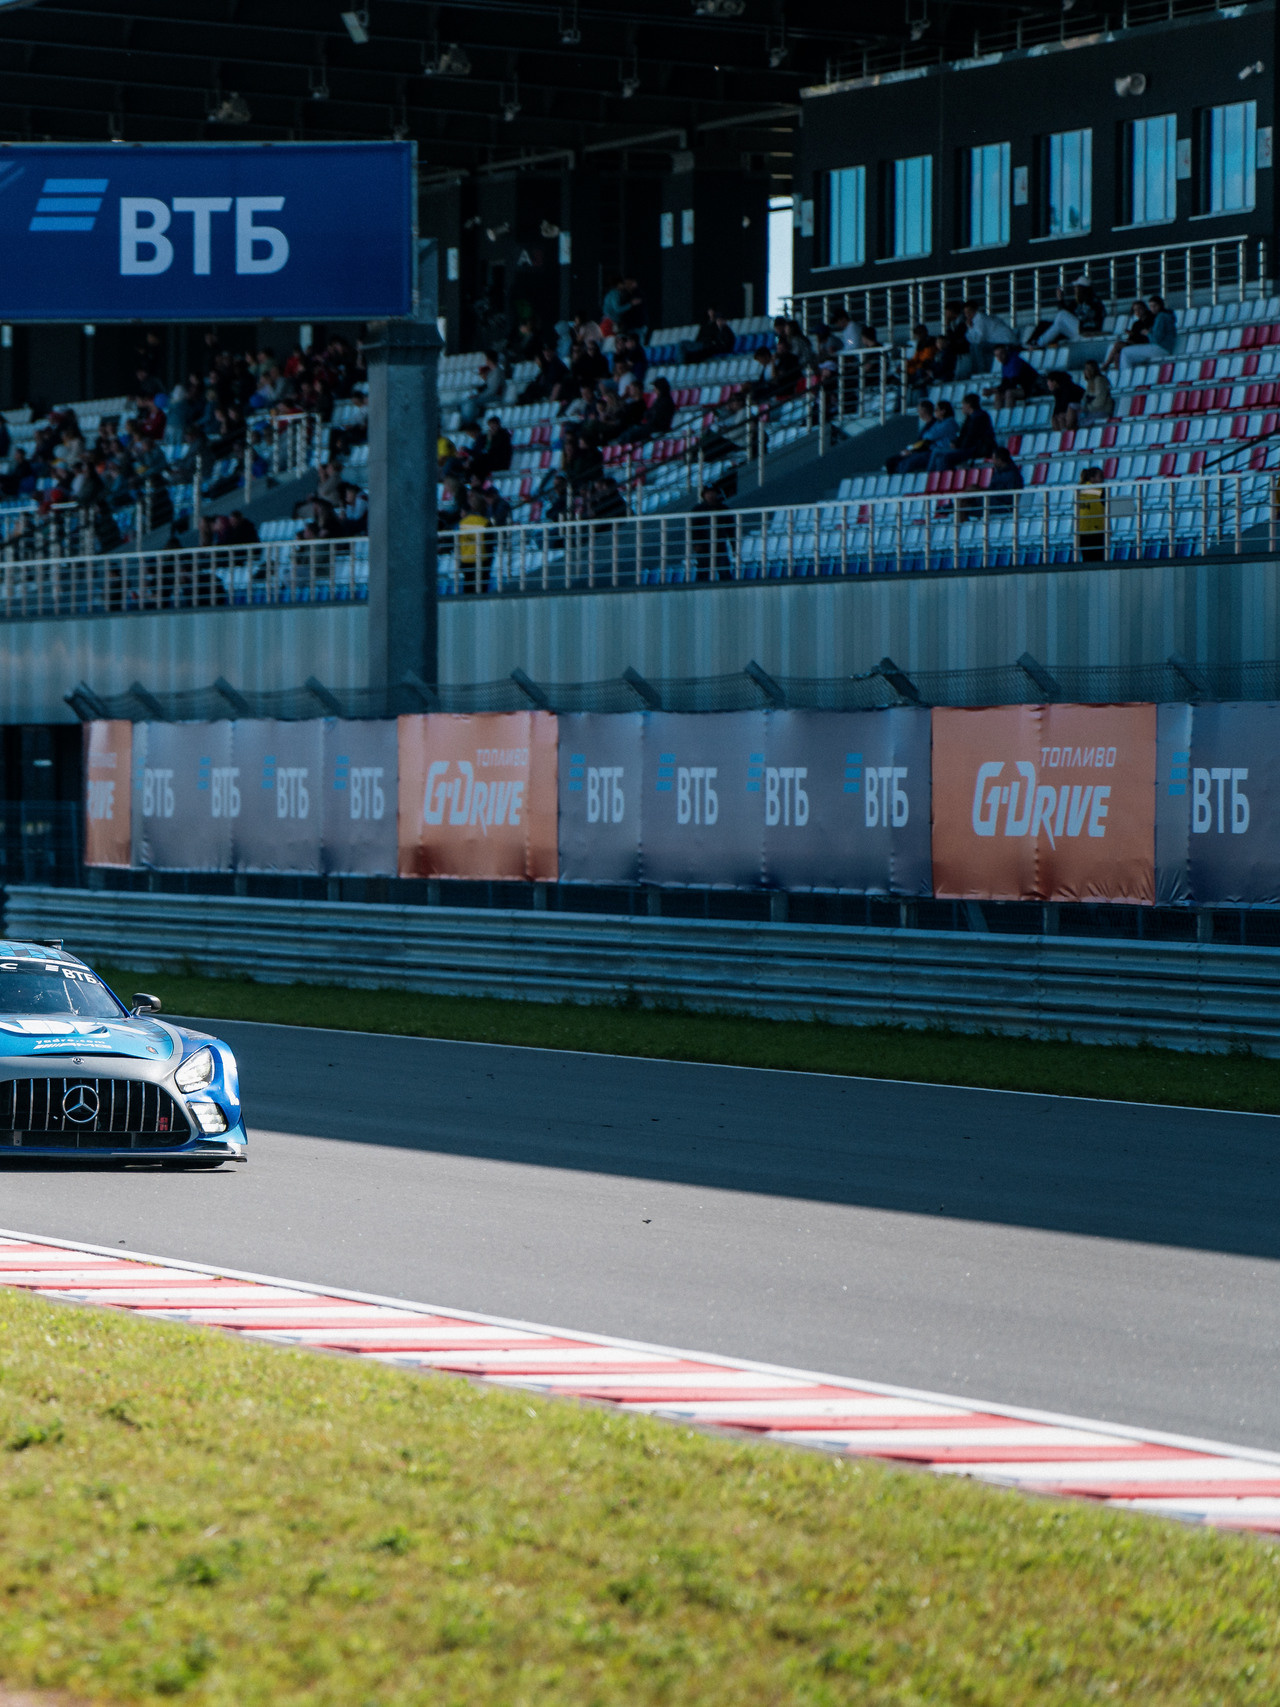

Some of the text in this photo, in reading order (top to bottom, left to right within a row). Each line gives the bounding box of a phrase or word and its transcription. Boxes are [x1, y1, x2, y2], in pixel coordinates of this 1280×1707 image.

[120, 196, 290, 276] ВТБ
[1041, 747, 1117, 767] ТОПЛИВО
[142, 769, 174, 817] ВТБ
[211, 768, 240, 818] ВТБ
[277, 768, 309, 819] ВТБ
[350, 767, 385, 819] ВТБ
[587, 767, 624, 823] ВТБ
[677, 767, 718, 825] ВТБ
[766, 767, 810, 826] ВТБ
[865, 767, 909, 828] ВТБ
[1193, 768, 1250, 834] ВТБ
[62, 968, 97, 984] ВТБ
